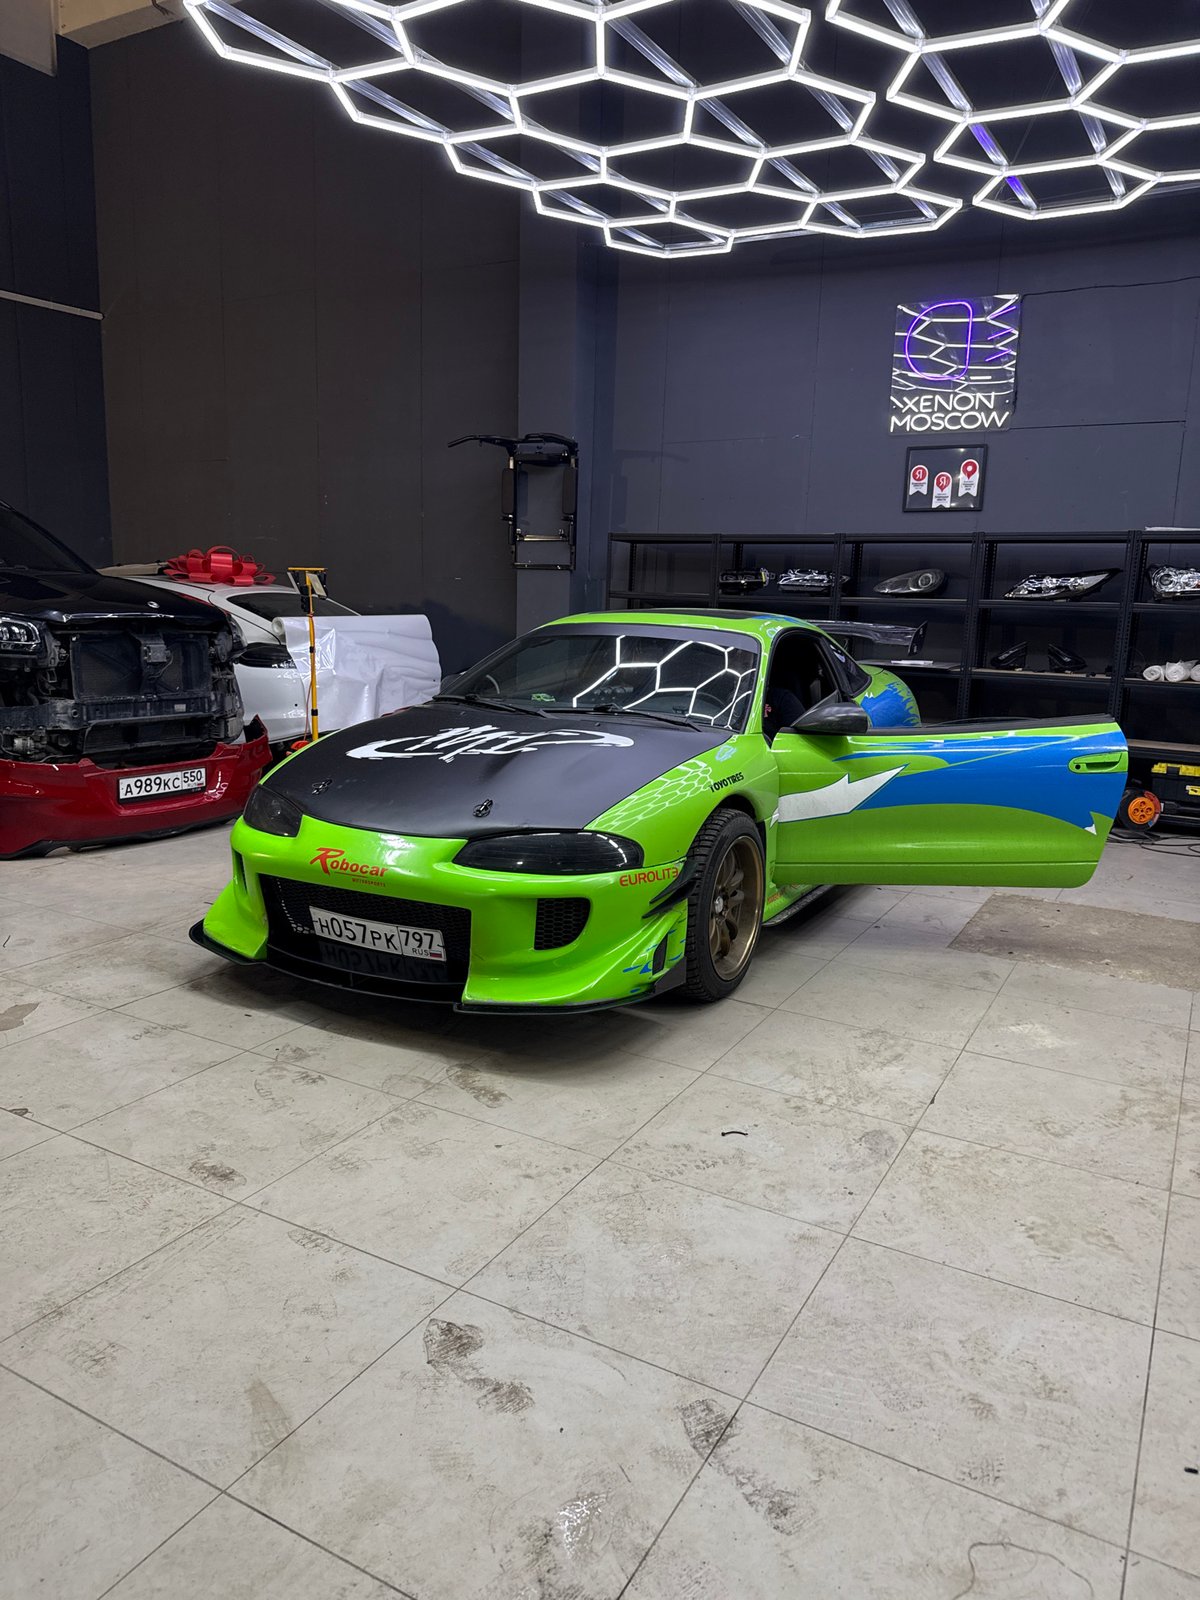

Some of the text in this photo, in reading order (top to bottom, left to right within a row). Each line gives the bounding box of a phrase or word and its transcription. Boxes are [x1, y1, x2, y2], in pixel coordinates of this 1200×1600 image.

[900, 392, 995, 413] XENON
[890, 411, 1009, 432] MOSCOW
[309, 847, 388, 876] Robocar
[412, 947, 429, 956] RUS
